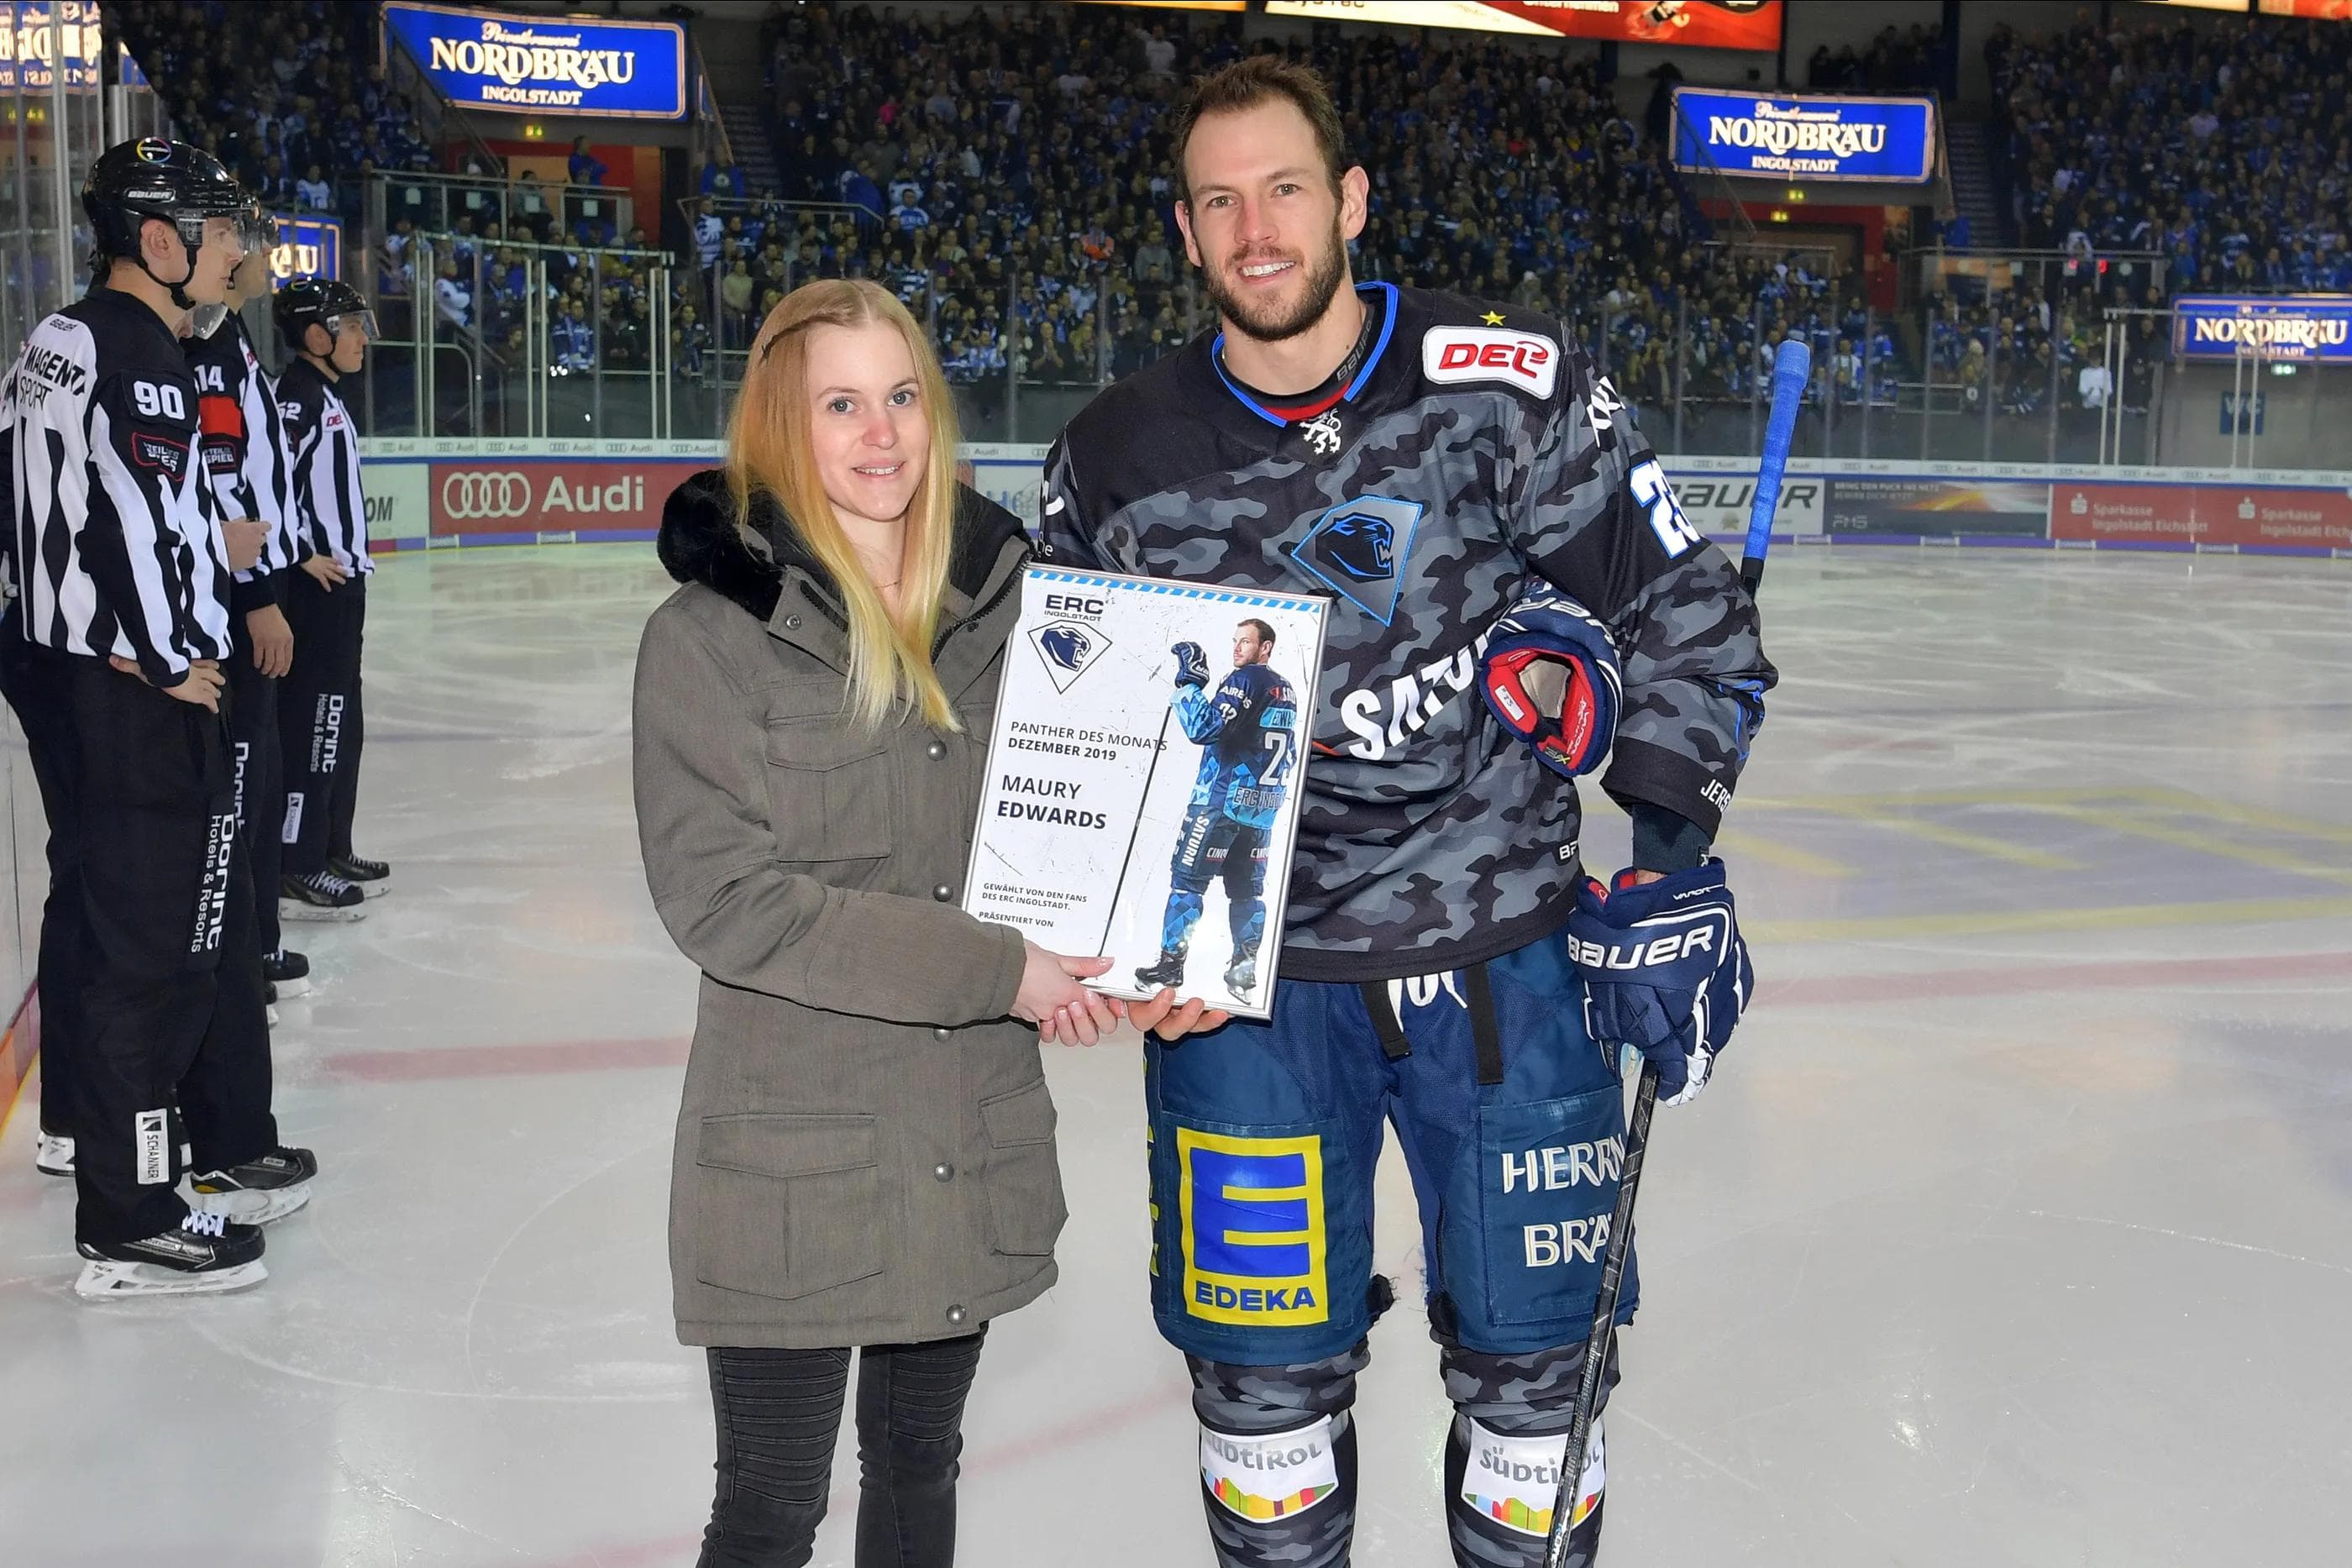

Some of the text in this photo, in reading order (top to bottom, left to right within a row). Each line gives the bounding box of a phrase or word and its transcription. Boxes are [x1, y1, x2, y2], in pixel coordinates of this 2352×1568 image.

[429, 37, 634, 89] NORDBRÄU
[482, 86, 582, 105] INGOLSTADT
[1709, 116, 1887, 158] NORDBRÄU
[1751, 155, 1839, 172] INGOLSTADT
[194, 364, 224, 392] 14
[20, 375, 52, 411] SPORT
[133, 380, 186, 421] 90
[541, 475, 644, 514] Audi
[2093, 503, 2153, 517] Sparkasse
[2261, 507, 2323, 522] Sparkasse
[2092, 518, 2153, 532] Ingolstadt
[2260, 523, 2322, 538] Ingolstadt
[1044, 610, 1102, 622] INGOLSTADT
[1045, 594, 1105, 616] ERC
[322, 695, 344, 774] Dorint
[1011, 721, 1168, 752] PANTHER DES MONATS
[1008, 737, 1117, 762] DEZEMBER 2019
[1001, 774, 1083, 800] MAURY
[997, 800, 1107, 830] EDWARDS
[1181, 815, 1210, 868] SATURN
[192, 815, 223, 953] Hotels & Resorts
[207, 813, 235, 950] Dorint
[984, 881, 1088, 903] GEWÄHLT VON DEN FANS
[982, 892, 1070, 910] DES ERC INGOLSTADT.
[979, 910, 1054, 927] PRÄSENTIERT VON
[147, 1134, 160, 1179] SCHANNER
[1501, 1133, 1625, 1194] HERRN
[1195, 1280, 1317, 1312] EDEKA
